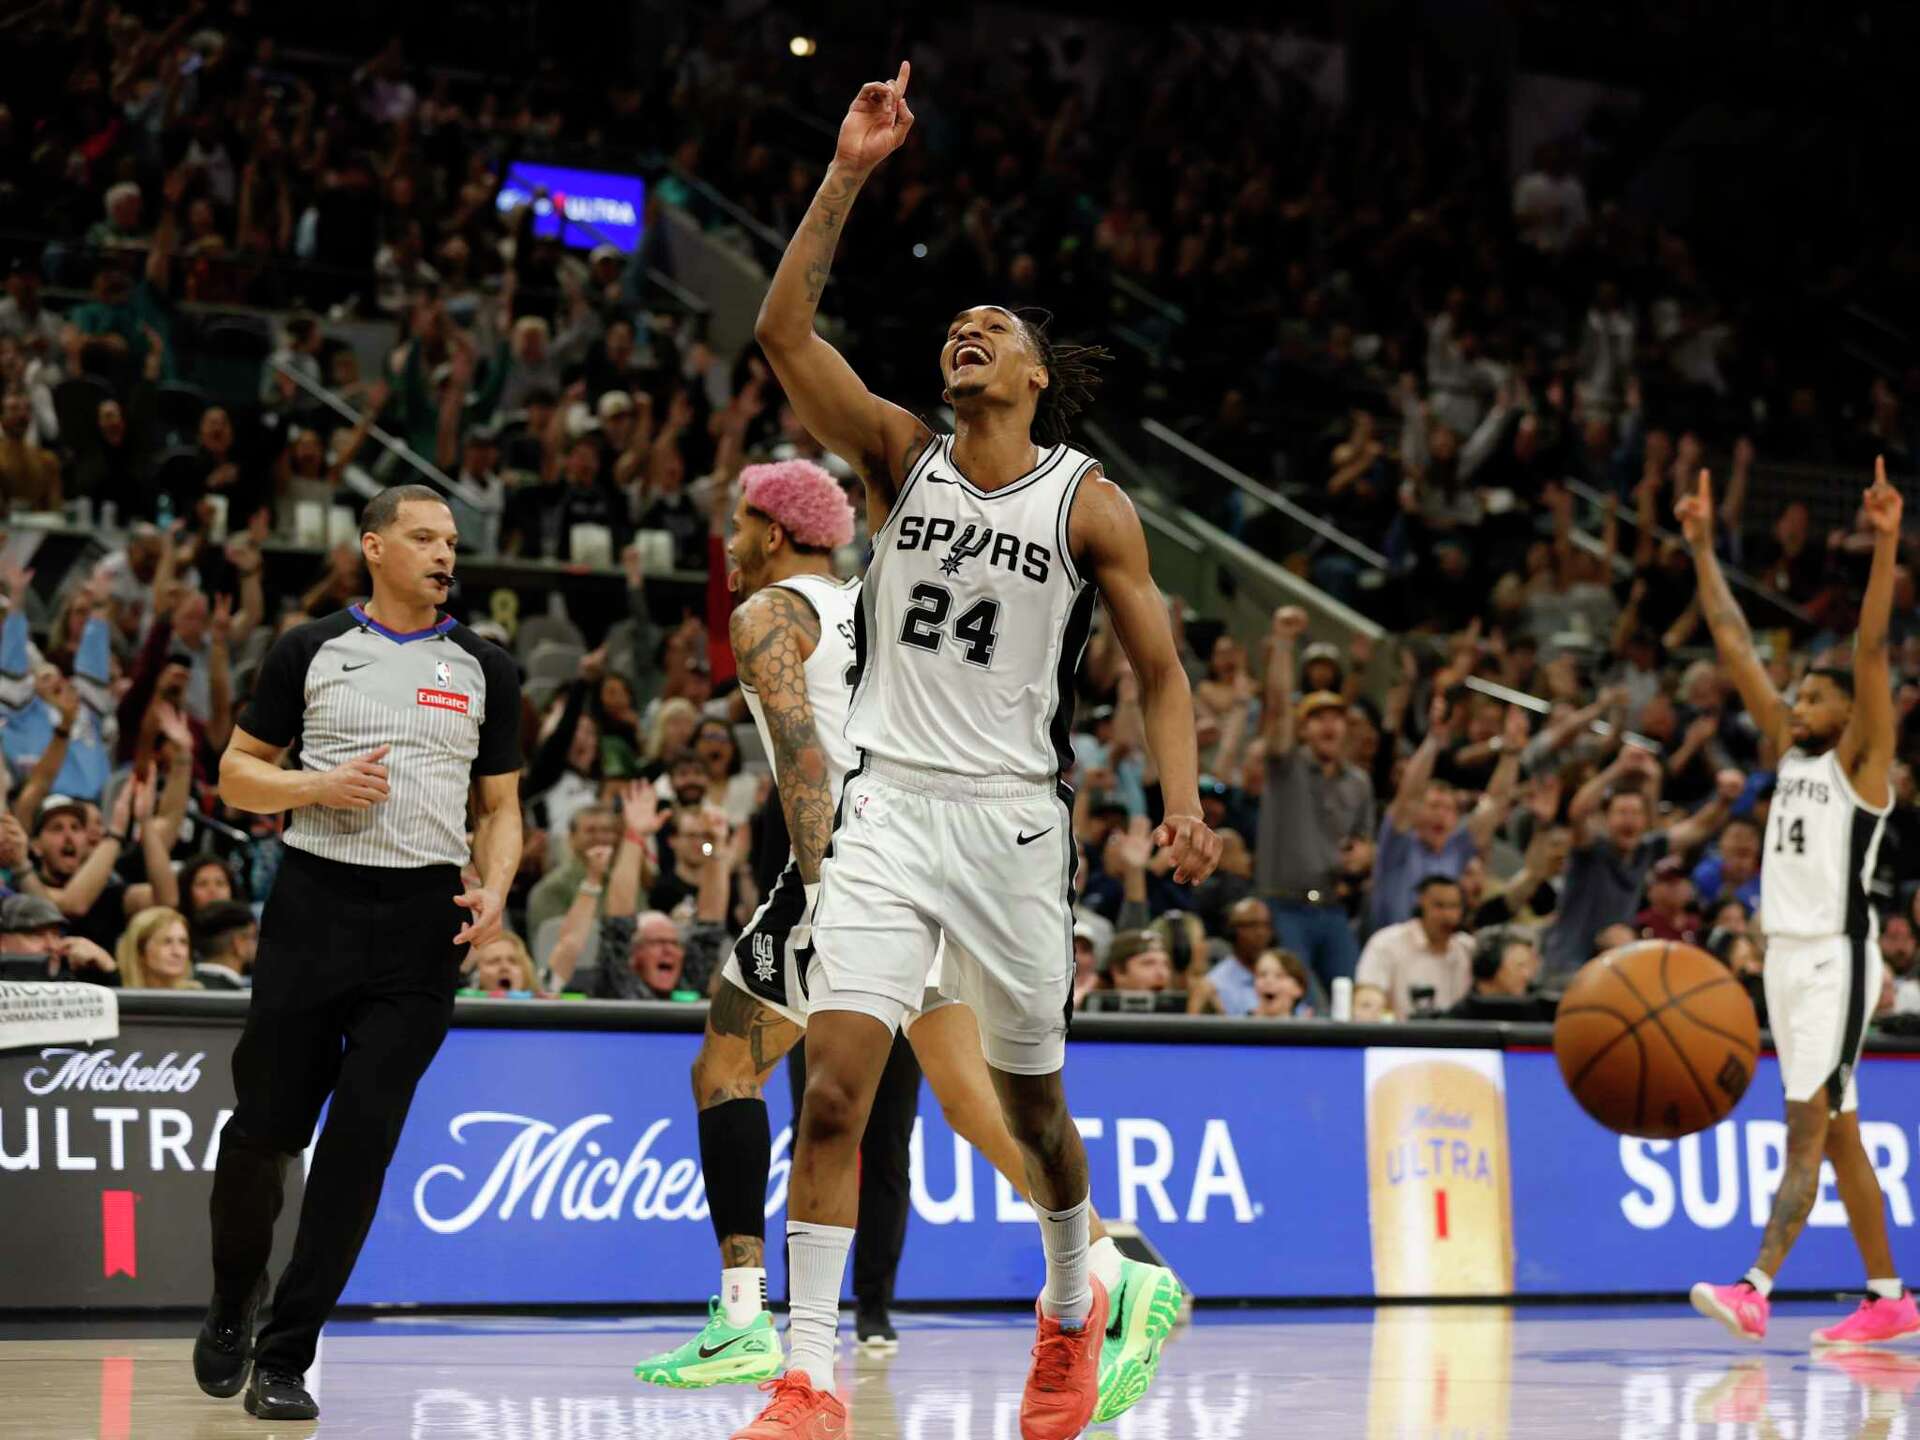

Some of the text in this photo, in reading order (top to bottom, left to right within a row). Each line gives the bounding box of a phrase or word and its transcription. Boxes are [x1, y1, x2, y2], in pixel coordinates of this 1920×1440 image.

[896, 515, 1052, 584] SPURS
[897, 580, 1001, 669] 24
[418, 691, 468, 710] Emirates
[1774, 815, 1806, 854] 14
[23, 1048, 206, 1095] Michelob
[414, 1111, 1256, 1234] Micheb ULRA
[1386, 1137, 1495, 1189] ULTRA
